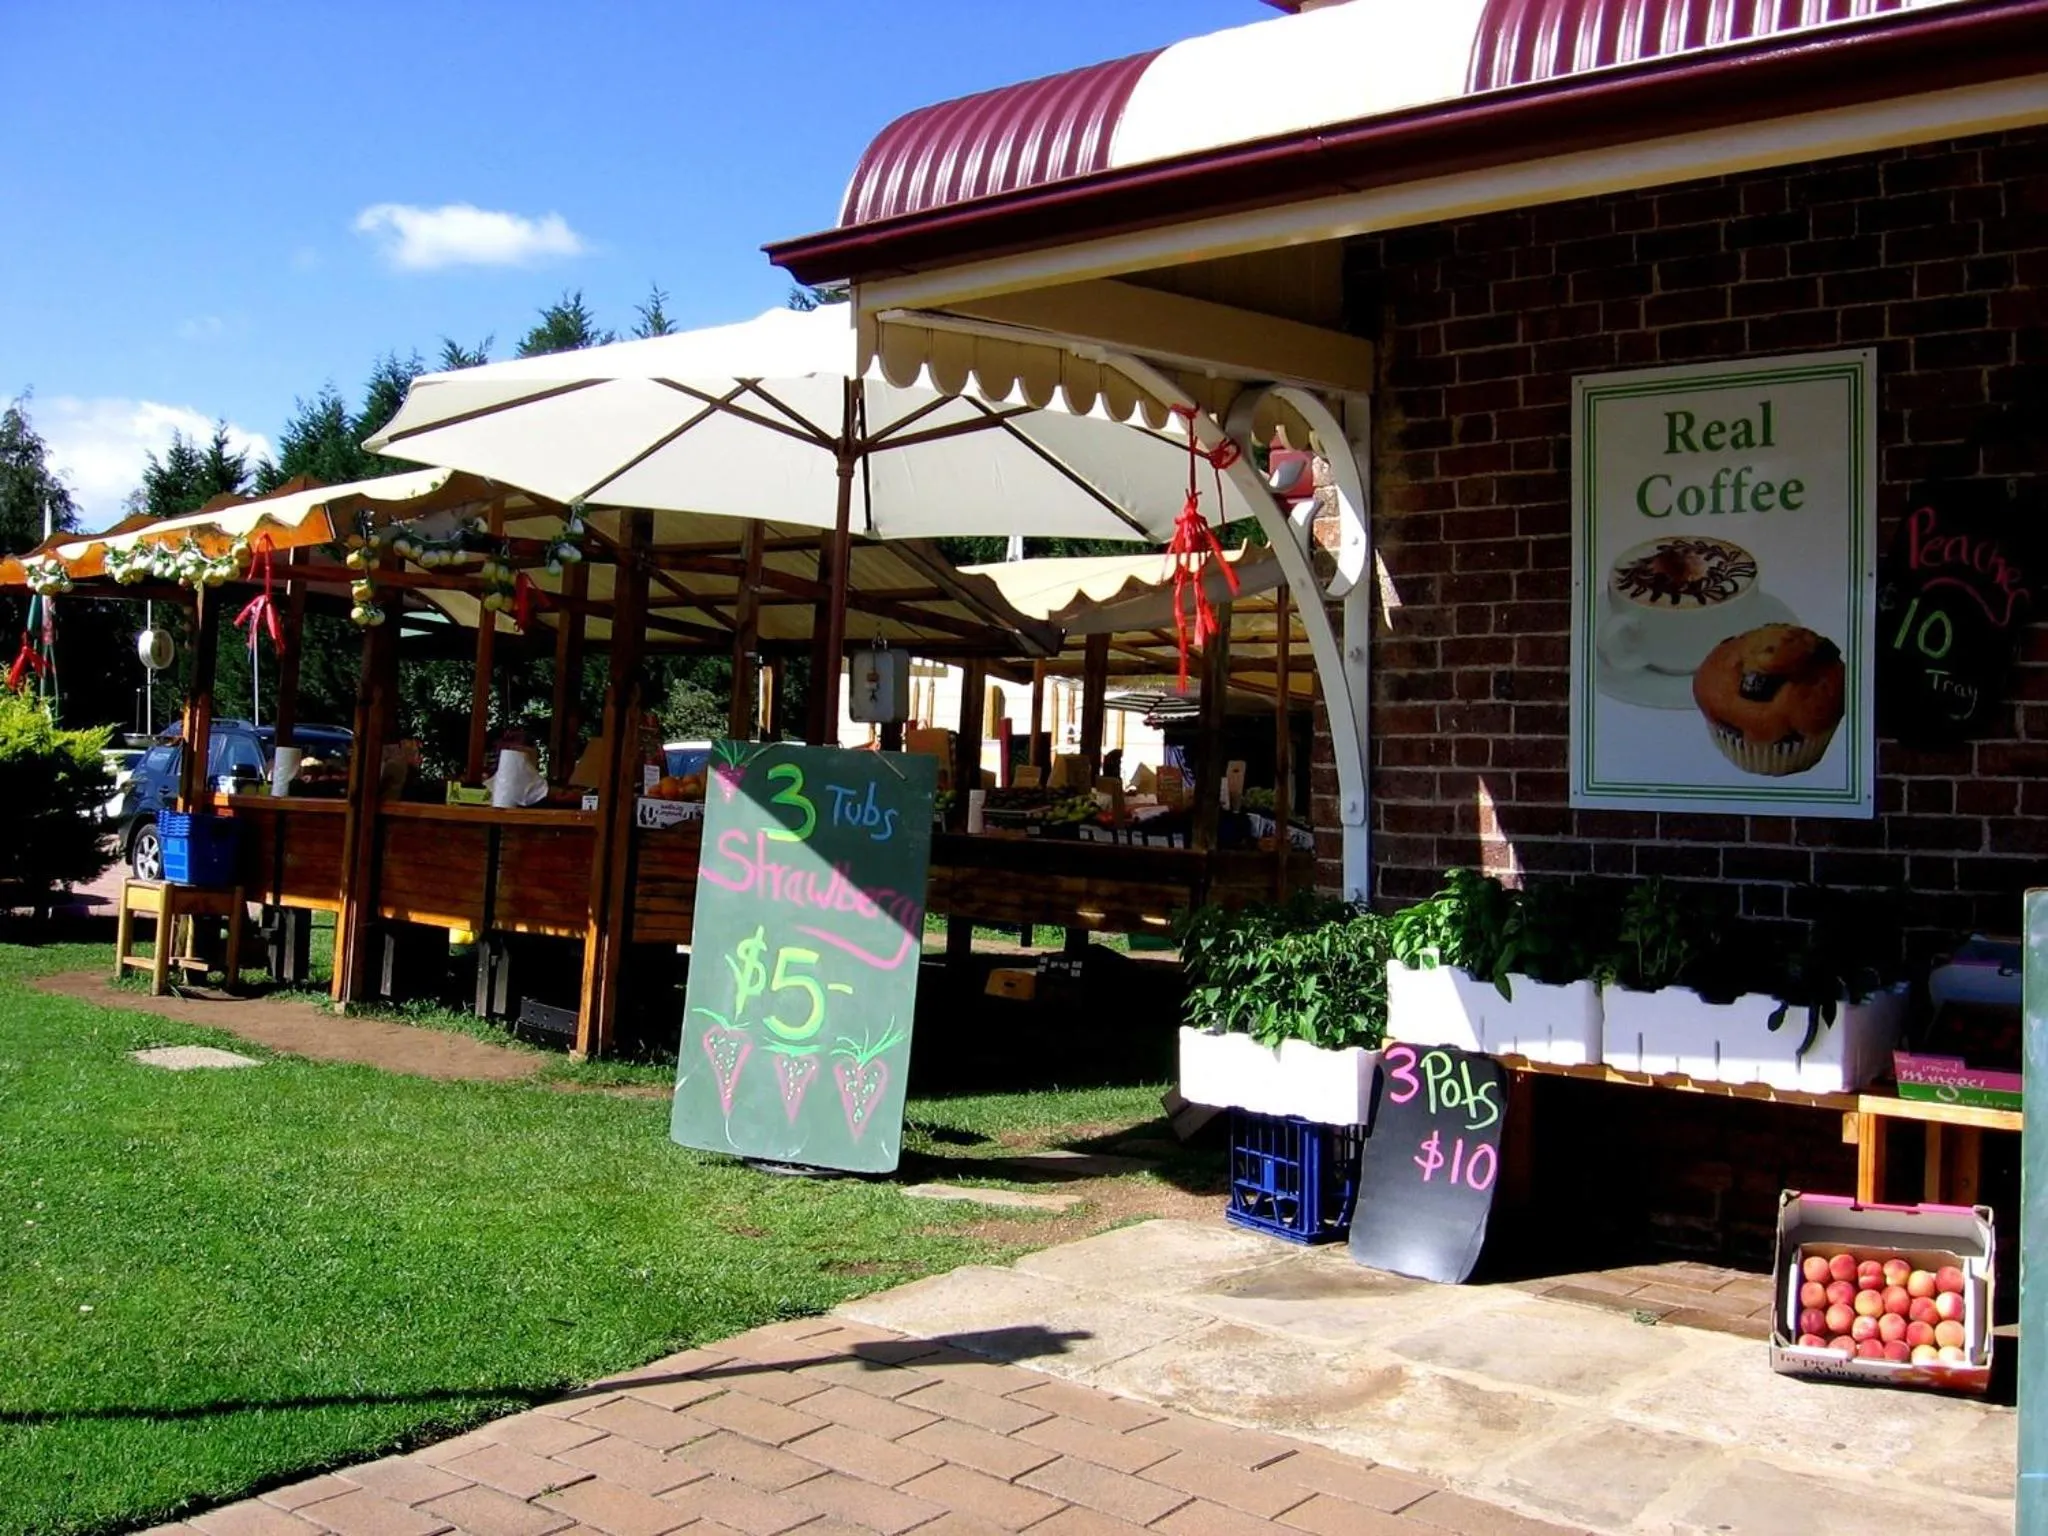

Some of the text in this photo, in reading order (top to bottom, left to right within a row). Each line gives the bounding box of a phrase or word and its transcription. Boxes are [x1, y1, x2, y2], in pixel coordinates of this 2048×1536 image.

[1663, 401, 1776, 455] Real
[1636, 465, 1805, 519] Coffee
[1893, 597, 1952, 659] 10
[1925, 668, 1977, 719] Tray
[766, 763, 898, 843] 3 Tubs
[1385, 1046, 1499, 1130] 3 Pots
[1413, 1130, 1498, 1191] $10
